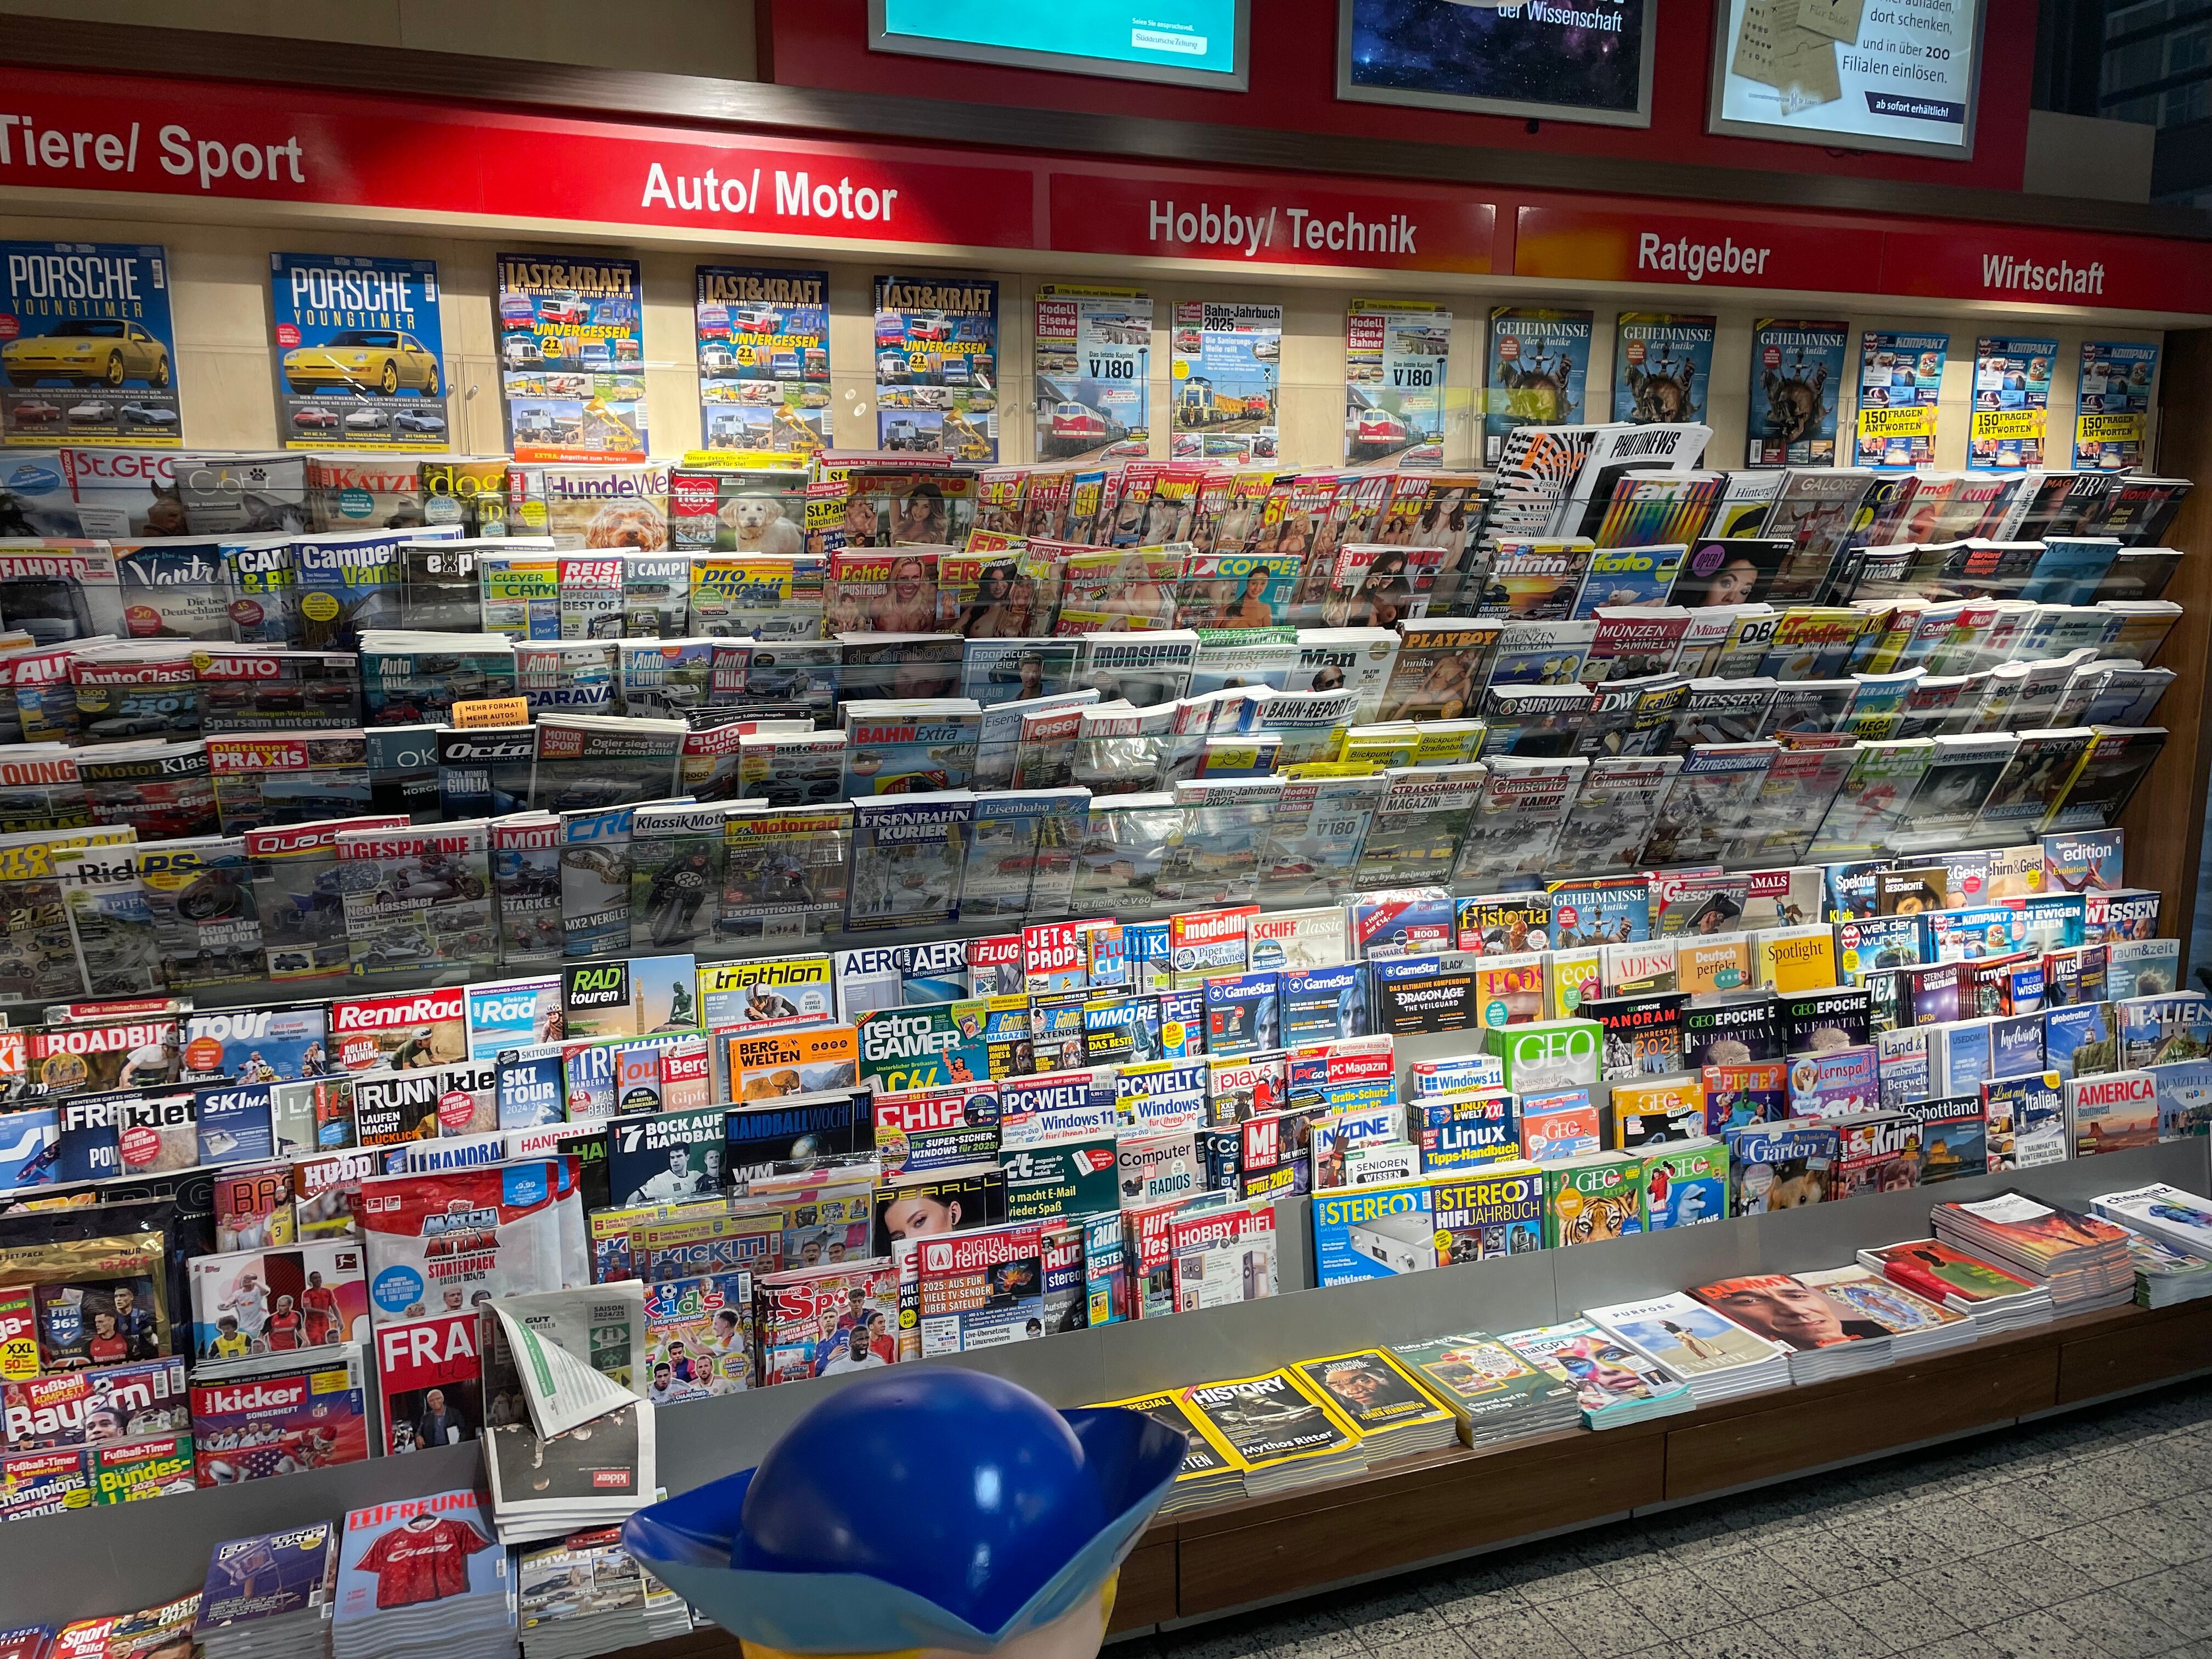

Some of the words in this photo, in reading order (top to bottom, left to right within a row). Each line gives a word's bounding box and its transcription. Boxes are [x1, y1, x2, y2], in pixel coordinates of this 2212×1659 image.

[1527, 1, 1622, 32] Wissenschaft
[1871, 8, 1894, 24] dort
[1898, 13, 1952, 35] schenken,
[1157, 21, 1194, 31] anspruchsvoll.
[1863, 39, 1883, 50] und
[1886, 40, 1895, 50] in
[1899, 42, 1922, 56] über
[1926, 47, 1950, 60] 200
[1843, 55, 1888, 75] Filialen
[1893, 63, 1947, 83] einlösen.
[1876, 100, 1886, 109] ab
[1887, 102, 1910, 112] sofort
[1911, 104, 1949, 117] erhältlich!
[0, 115, 139, 172] Tiere/
[159, 125, 304, 189] Sport
[641, 162, 760, 214] Auto/
[775, 170, 898, 222] Motor
[1149, 199, 1277, 256] Hobby/
[1286, 208, 1418, 254] Technik
[1638, 233, 1770, 281] Ratgeber
[8, 255, 140, 300] PORSCHE
[1982, 254, 2104, 295] Wirtschaft
[292, 267, 414, 313] PORSCHE
[12, 300, 143, 318] YOUNGTIMER
[1039, 304, 1076, 314] Modell
[1204, 304, 1280, 319] Bahn-Jahrbuch
[294, 309, 416, 330] YOUNGTIMER
[1039, 314, 1068, 325] Eisen
[1204, 317, 1234, 331] 2025
[533, 324, 631, 339] UNVERGESSEN
[1038, 325, 1076, 336] Bahner
[1496, 321, 1589, 338] GEHEIMNISSE
[544, 339, 560, 349] 21
[1116, 352, 1133, 360] Kapitel
[1090, 359, 1104, 377] V
[1105, 359, 1133, 378] 180
[1865, 411, 1887, 424] 150
[1888, 409, 1923, 419] FRAGEN
[1865, 423, 1921, 432] ANTWORTEN
[1610, 431, 1681, 459] PHOTONEWS
[560, 454, 588, 462] Angstfrei
[494, 573, 543, 583] CLEVER
[1406, 631, 1498, 647] PLAYBOY
[1599, 623, 1666, 639] MÜNZEN
[1613, 638, 1678, 650] SAMMELN
[202, 659, 276, 676] AUTO
[465, 703, 487, 712] MEHR
[489, 702, 522, 710] FORMAT!
[1268, 697, 1348, 719] BAHN-REPORT
[1515, 699, 1589, 713] SURVIVAL
[204, 718, 272, 729] Sparsam
[275, 716, 358, 729] unterwegs
[490, 712, 518, 720] AUTOS!
[545, 731, 581, 741] MOTOR
[592, 739, 623, 748] Ogier
[625, 740, 653, 749] siegt
[545, 740, 581, 751] SPORT
[212, 751, 304, 769] PRAXIS
[447, 778, 490, 793] GIULIA
[860, 809, 970, 828] EISENBAHN
[879, 825, 947, 840] KURIER
[2063, 844, 2112, 862] edition
[1552, 889, 1646, 906] GEHEIMNISSE
[727, 902, 839, 917] EXPEDITIONSMOBIL
[1602, 902, 1628, 911] Antike
[2036, 906, 2080, 919] EWIGEN
[2027, 918, 2063, 931] LEBEN
[1027, 928, 1058, 948] JET
[1061, 929, 1073, 944] &
[978, 943, 1018, 962] FLUG
[1027, 946, 1074, 969] PROP
[1696, 948, 1736, 962] Deutsch
[1768, 940, 1823, 962] Spotlight
[2112, 941, 2174, 960] raum&zeit
[715, 968, 822, 989] triathlon
[1697, 961, 1736, 979] perfekt
[573, 968, 620, 990] RAD
[1404, 981, 1431, 991] ULTIMATIVE
[1434, 978, 1470, 988] KOMPENDIUM
[571, 990, 618, 1005] touren
[1224, 983, 1276, 998] GameStar
[1395, 991, 1441, 1005] DRAGON
[1442, 987, 1465, 999] AGE
[481, 997, 535, 1023] Rad
[1420, 1001, 1458, 1010] VEILGUARD
[1816, 997, 1867, 1014] EPOCHE
[864, 1016, 932, 1040] retro
[343, 1040, 373, 1055] ROLLEN
[740, 1040, 778, 1053] BERG
[866, 1030, 960, 1061] GAMER
[1514, 1030, 1596, 1070] GEO
[342, 1048, 379, 1062] TRAINING
[741, 1049, 800, 1066] WELTEN
[1331, 1063, 1344, 1074] PC
[1346, 1061, 1387, 1074] Magazin
[502, 1067, 537, 1086] SKI
[502, 1082, 554, 1103] TOUR
[2078, 1080, 2155, 1107] AMERICA
[360, 1111, 400, 1124] LAUFEN
[878, 1100, 963, 1130] CHIP
[1908, 1099, 1979, 1120] Schottland
[362, 1122, 398, 1133] MACHT
[1042, 1114, 1098, 1130] Windows
[1100, 1111, 1114, 1124] 11
[911, 1140, 924, 1149] Ihr
[926, 1132, 996, 1147] SUPER-SICHER-
[1443, 1125, 1506, 1148] Linux
[912, 1144, 957, 1158] WINDOWS
[959, 1142, 972, 1152] für
[974, 1141, 998, 1150] 2025!
[1120, 1143, 1190, 1166] Computer
[1427, 1142, 1519, 1166] Tipps-Handbuch
[2021, 1147, 2063, 1160] WINTERKULISSEN
[2024, 1141, 2058, 1152] TRAUMHAFTE
[1357, 1159, 1408, 1171] SENIOREN
[1363, 1170, 1402, 1181] WISSEN
[1150, 1174, 1190, 1195] RADIOS
[2107, 1186, 2172, 1205] chemnitz
[1179, 1222, 1233, 1246] HOBBY
[1239, 1216, 1271, 1234] HiFi
[962, 1237, 1006, 1254] DIGITAL
[955, 1244, 1038, 1268] fernsehen
[428, 1256, 496, 1279] STARTERPACK
[439, 1276, 461, 1286] SAISON
[464, 1272, 486, 1283] 2024/25
[923, 1282, 947, 1292] 2025:
[949, 1279, 963, 1289] AUS
[966, 1277, 981, 1286] FÜR
[924, 1293, 948, 1303] VIELE
[950, 1285, 991, 1300] TV-SENDER
[924, 1301, 947, 1313] ÜBER
[949, 1297, 983, 1310] SATELLIT
[1612, 1304, 1674, 1318] PURPOSE
[30, 1375, 84, 1397] Fußball
[1192, 1376, 1286, 1404] HISTORY
[216, 1386, 302, 1413] kicker
[246, 1406, 298, 1420] SONDERHEFT
[103, 1442, 174, 1461] Fußball-Timer
[1243, 1441, 1294, 1455] Mythos
[1296, 1431, 1333, 1445] Ritter
[62, 1622, 111, 1649] Sport
[75, 1641, 105, 1655] Bild
